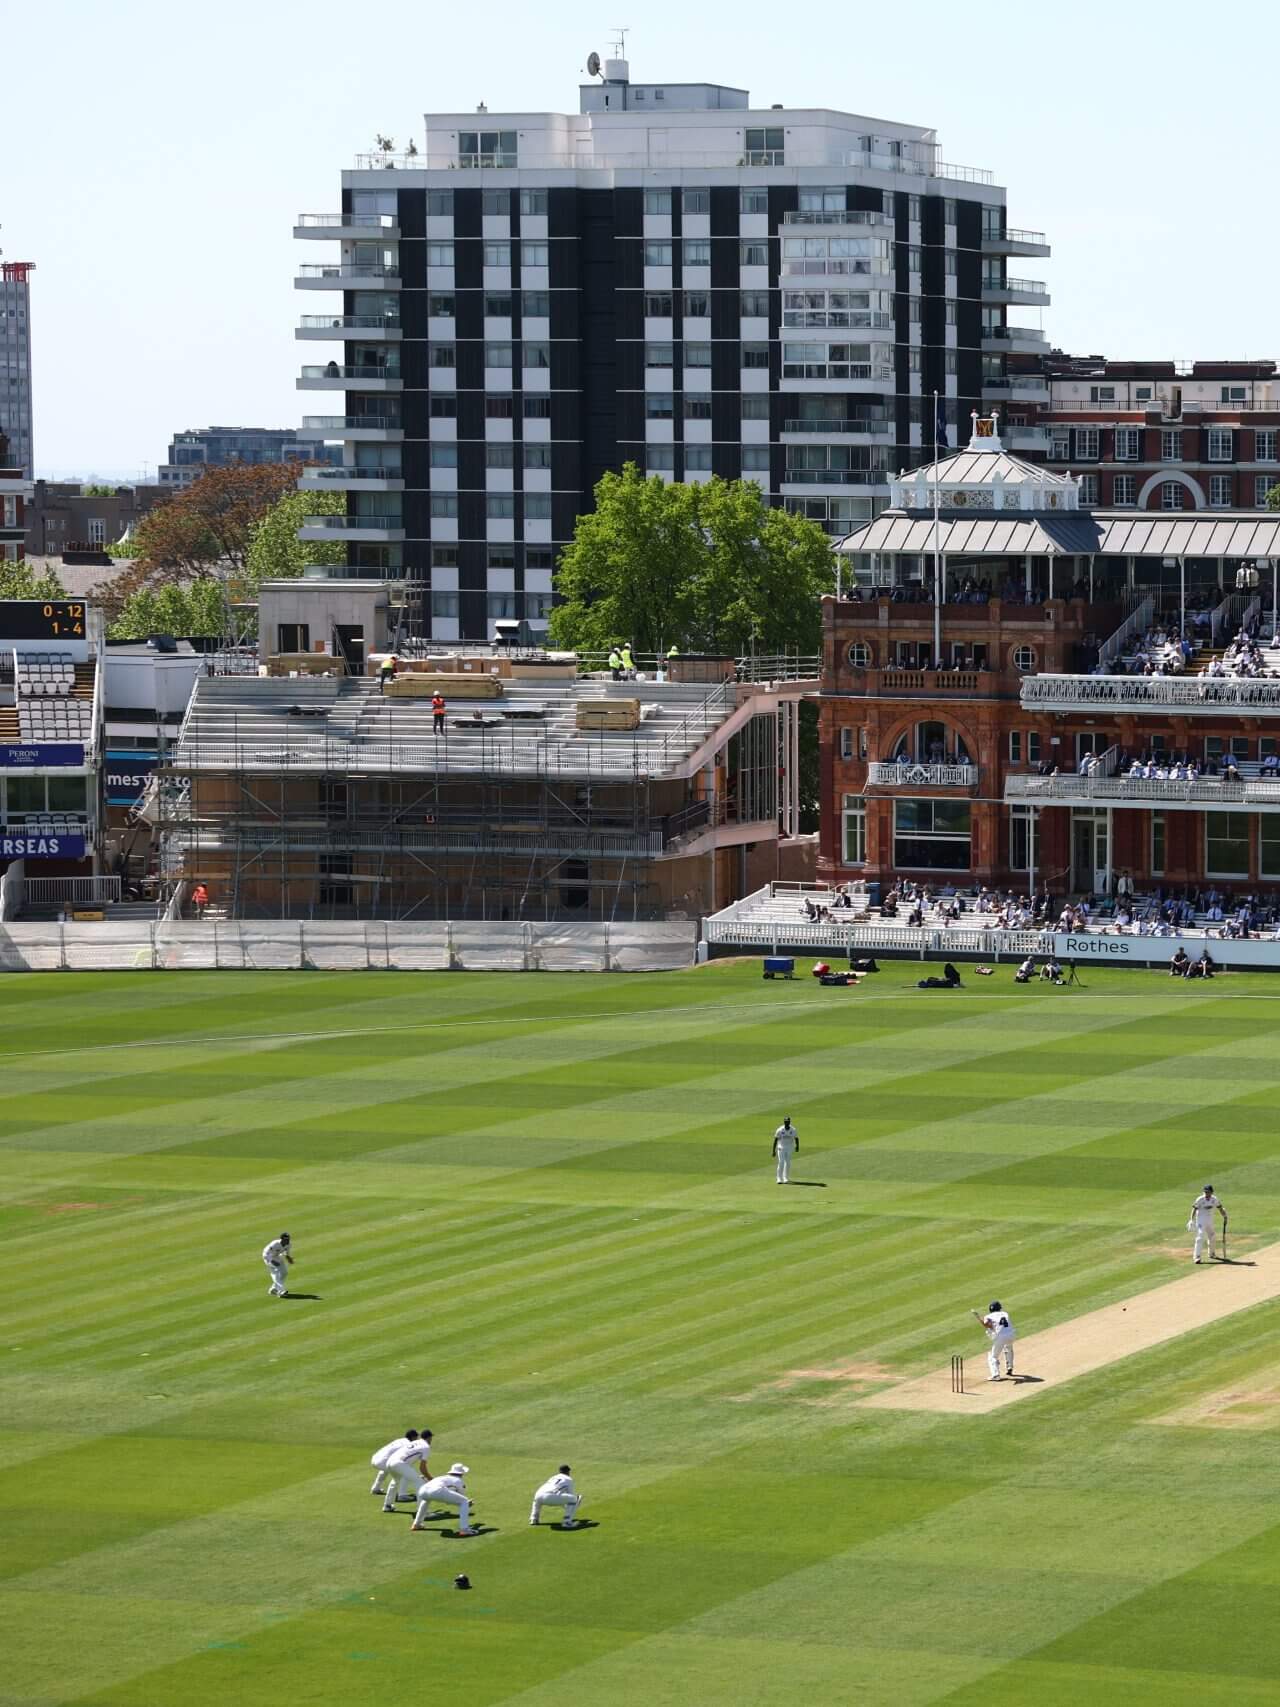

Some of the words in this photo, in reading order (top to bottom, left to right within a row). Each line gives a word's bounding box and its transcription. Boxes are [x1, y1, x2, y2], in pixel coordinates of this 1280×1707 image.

[43, 605, 53, 617] 0
[67, 605, 82, 618] 12
[52, 621, 59, 634] 1
[72, 622, 82, 634] 4
[1066, 938, 1129, 954] Rothes
[999, 1316, 1008, 1328] 4
